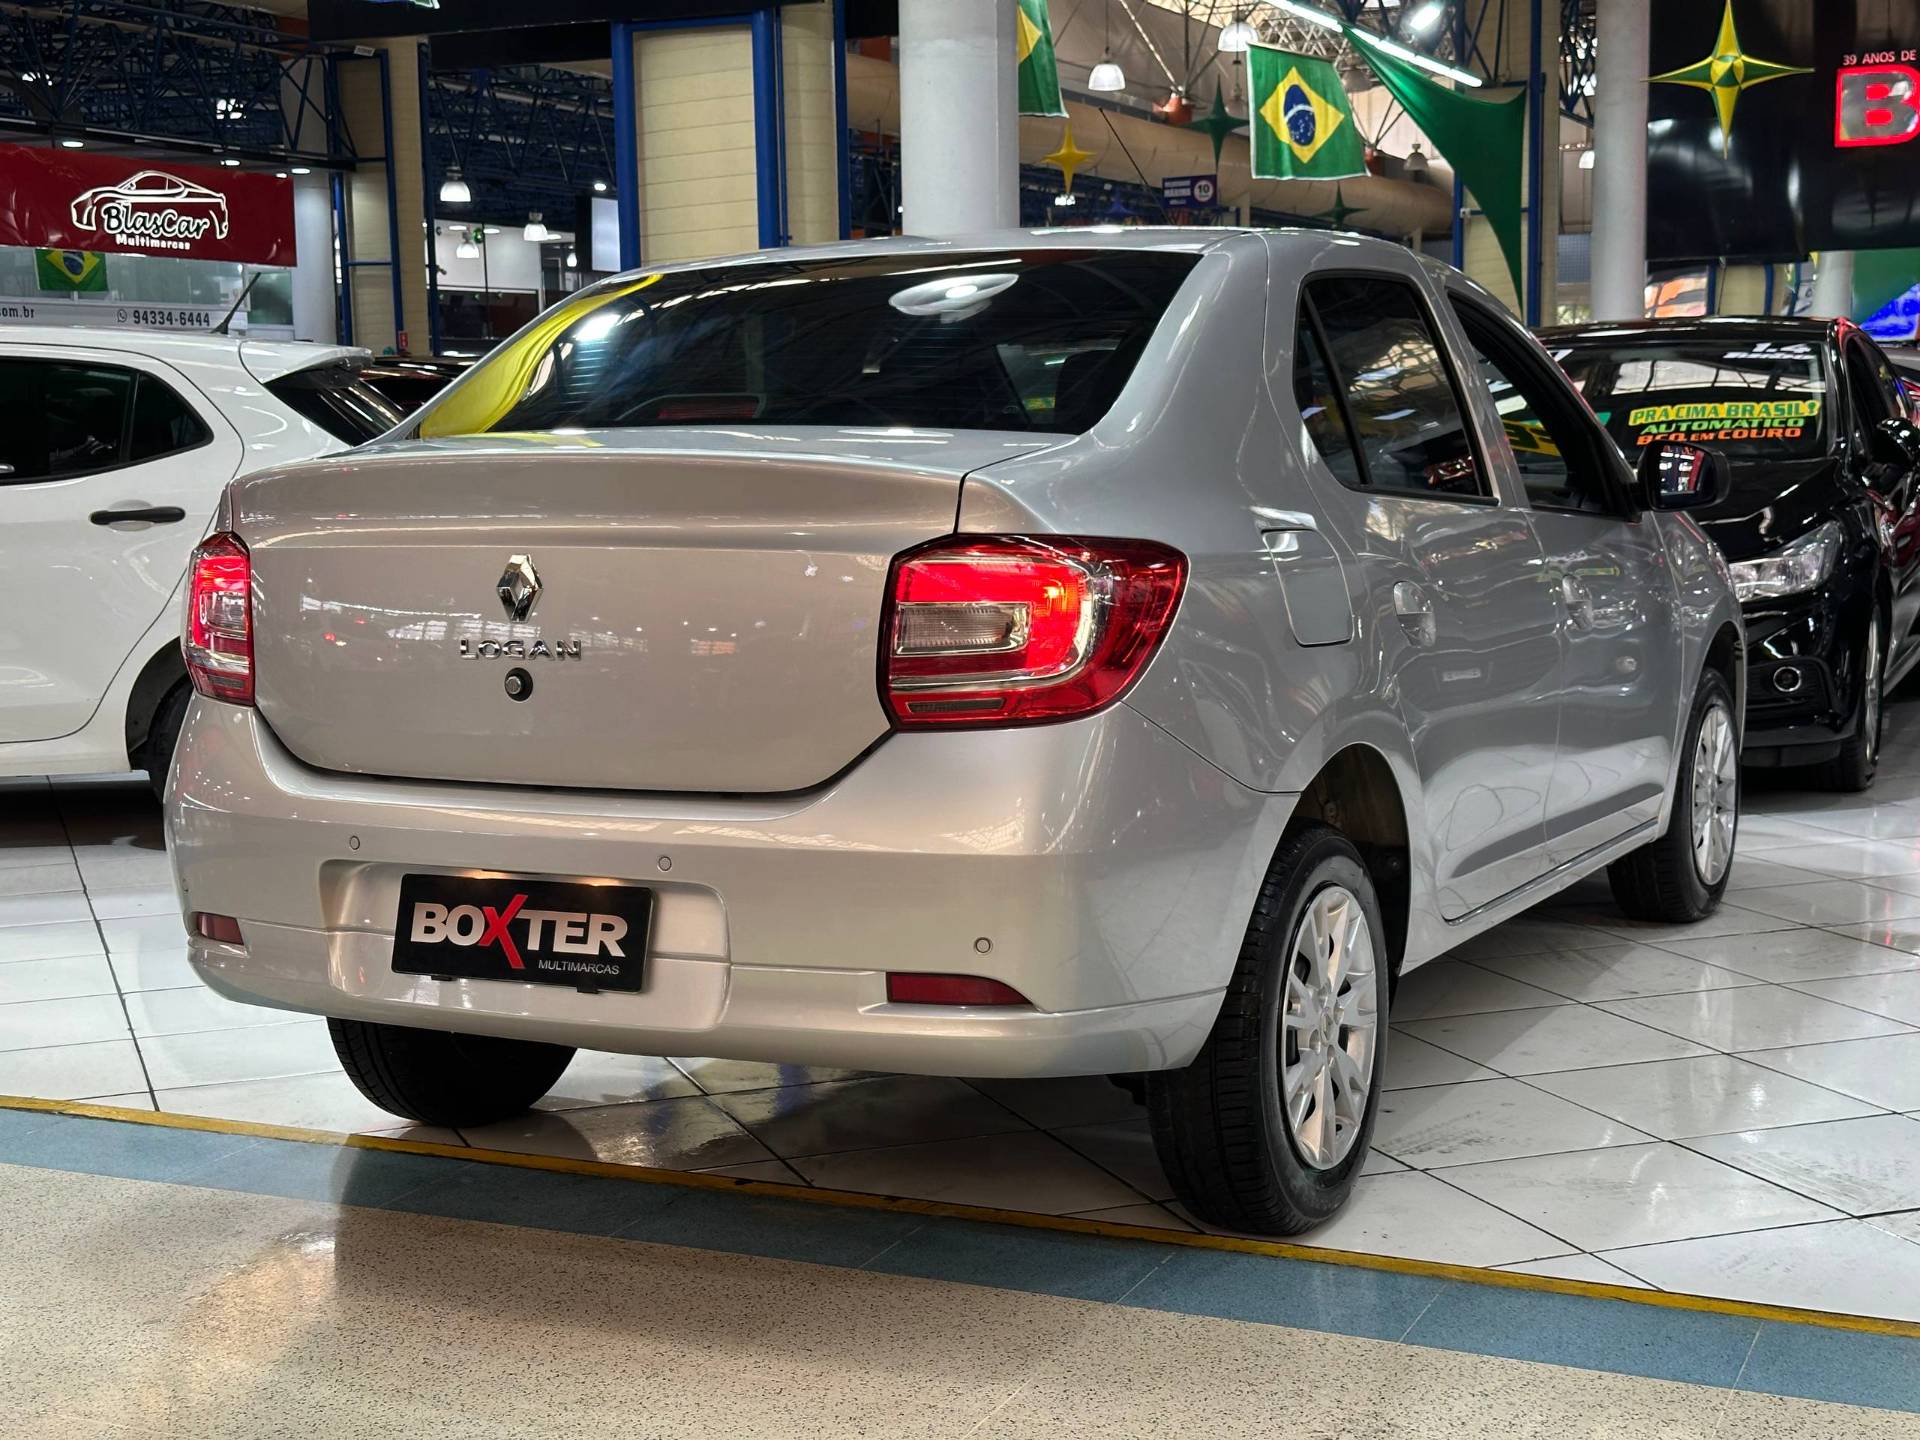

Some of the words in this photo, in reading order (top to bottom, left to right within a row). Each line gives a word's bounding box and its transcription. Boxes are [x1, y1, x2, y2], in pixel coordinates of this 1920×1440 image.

[1842, 54, 1857, 65] 39
[1862, 52, 1895, 64] ANOS
[1900, 50, 1917, 62] DE
[1198, 184, 1210, 193] 10
[102, 200, 210, 238] BlasCar
[0, 305, 35, 319] om.br
[132, 309, 211, 327] 94334-6444
[1675, 403, 1720, 420] CIMA
[1717, 427, 1803, 440] COURO
[460, 640, 581, 660] LOGAN
[410, 894, 628, 969] BOXTER
[538, 959, 620, 975] MULTIMARCAS
